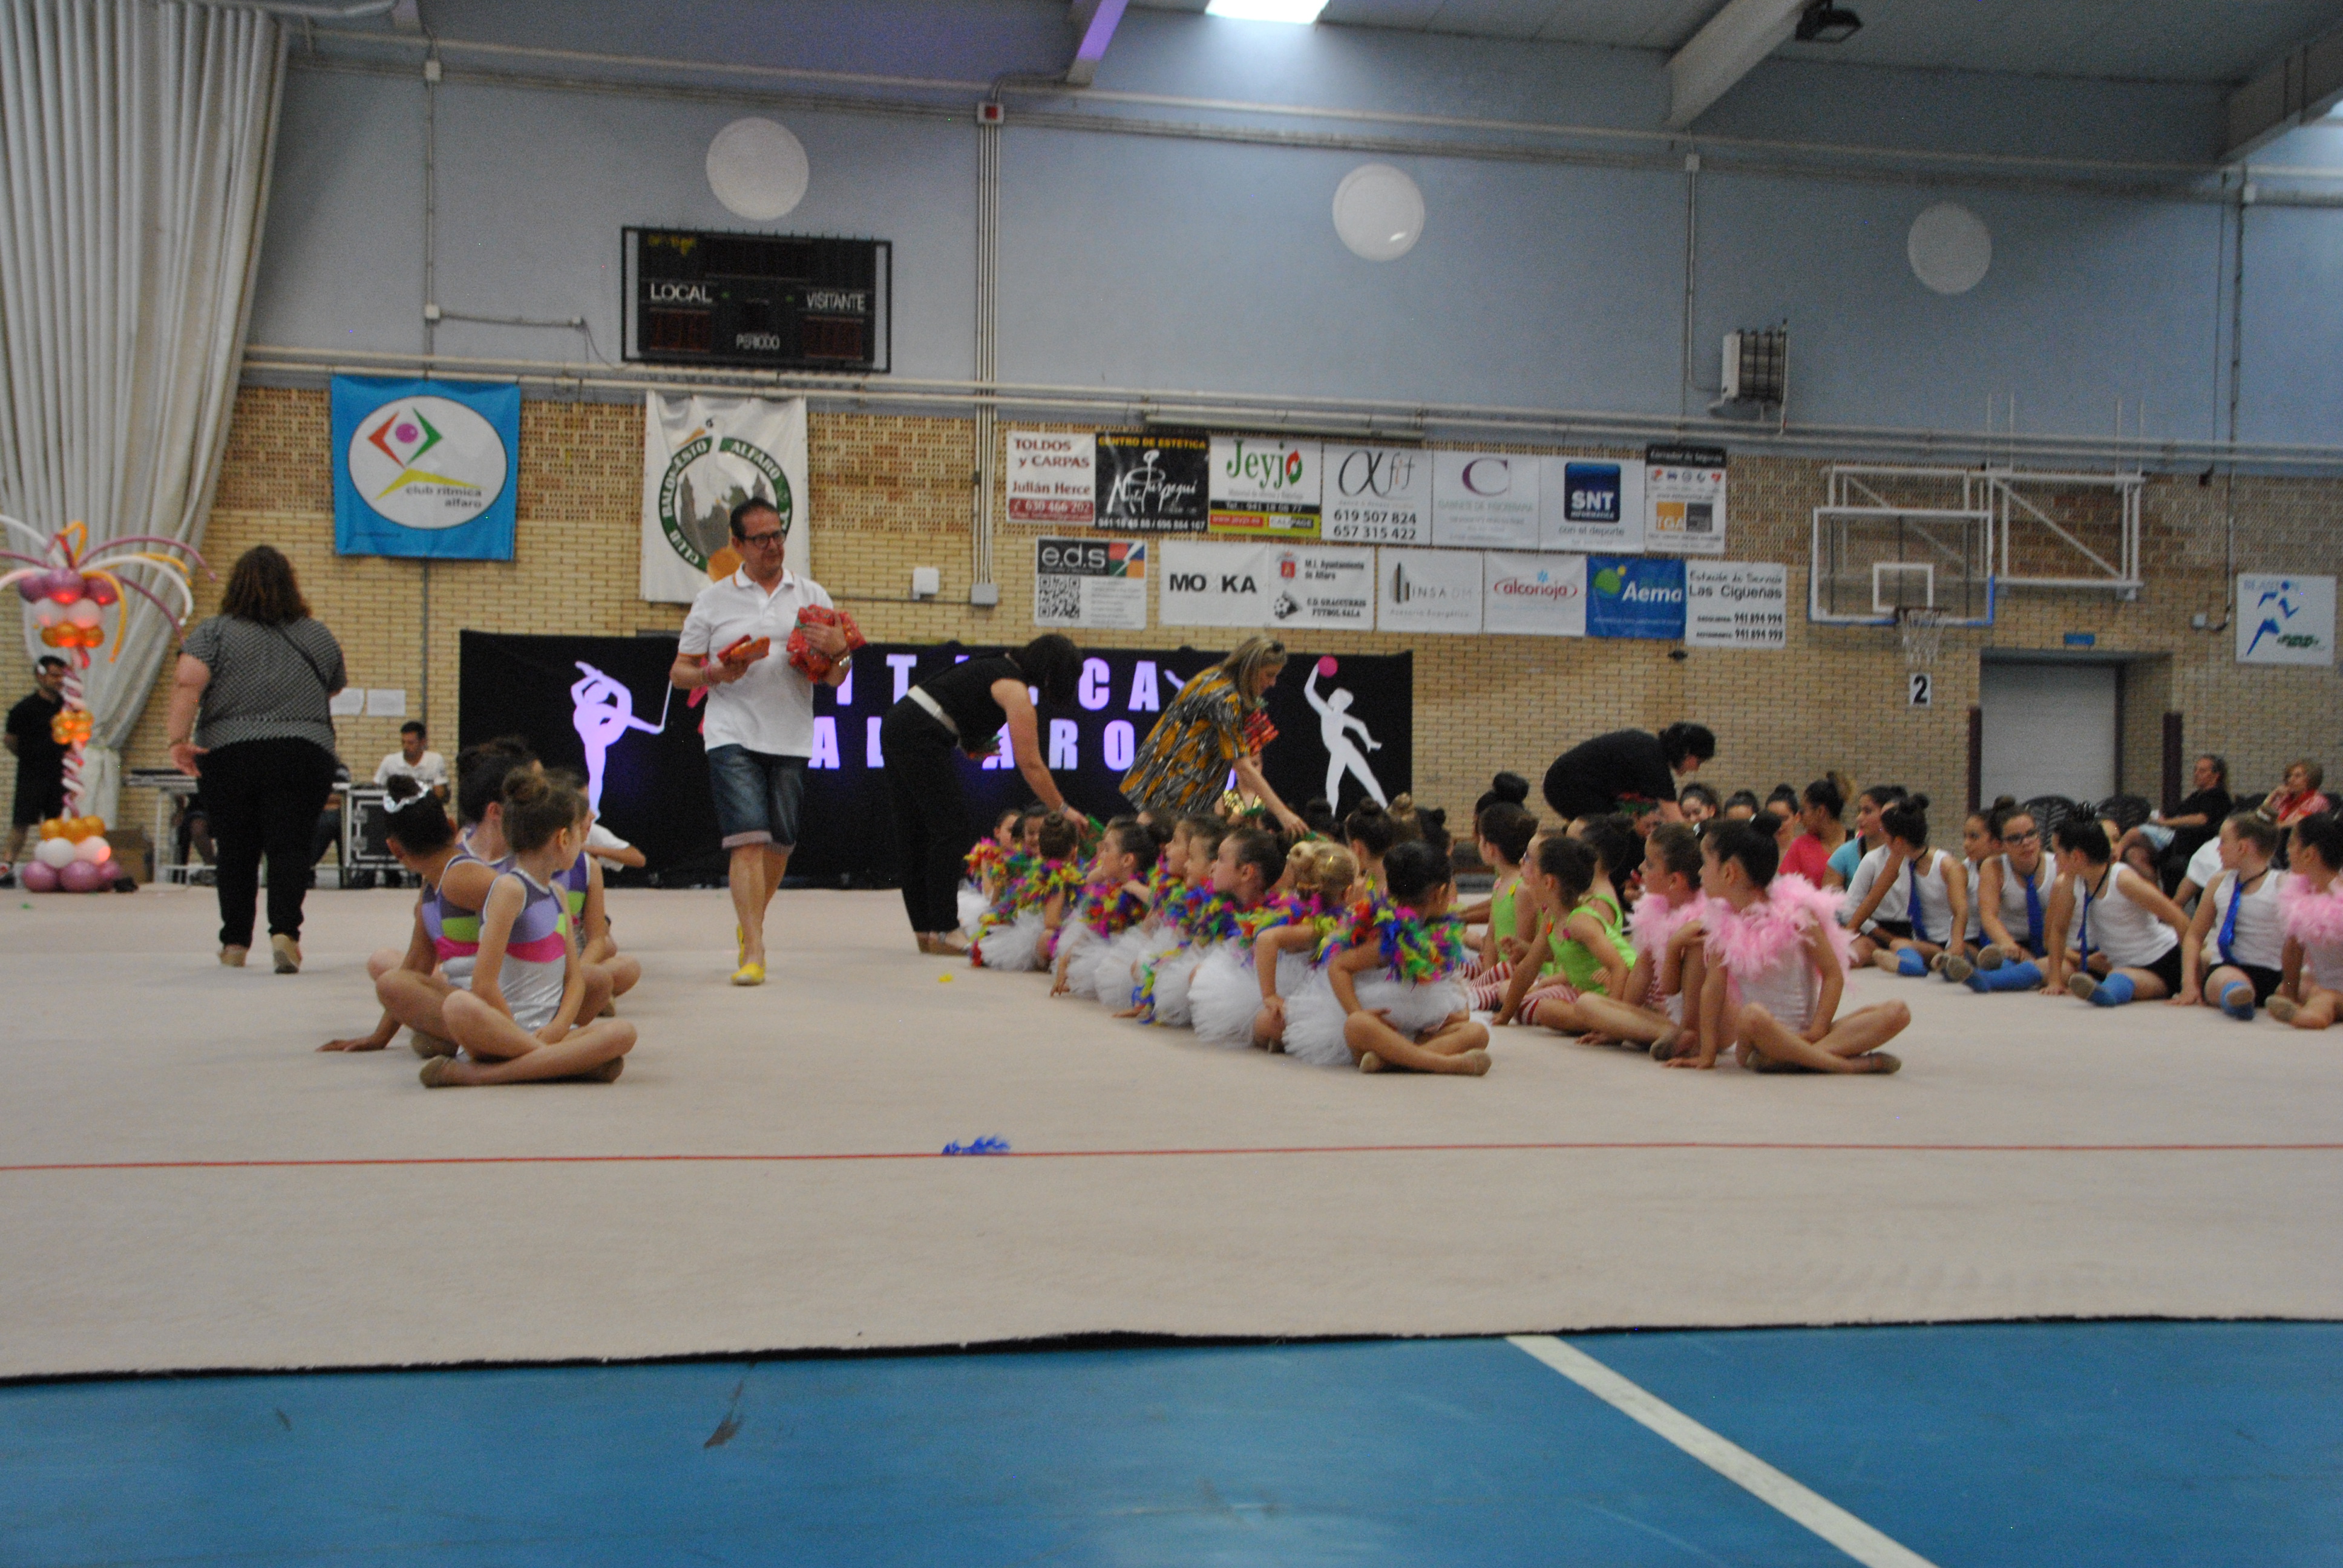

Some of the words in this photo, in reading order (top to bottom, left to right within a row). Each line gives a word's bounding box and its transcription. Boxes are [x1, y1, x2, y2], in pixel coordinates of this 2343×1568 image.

[650, 283, 713, 301] LOCAL
[807, 292, 865, 311] VISITANTE
[1014, 438, 1072, 452] TOLDOS
[730, 440, 781, 480] ALFARO
[1018, 457, 1027, 468] y
[1032, 454, 1090, 468] CARPAS
[662, 440, 707, 518] BALOESTO
[406, 486, 433, 496] club
[445, 498, 482, 508] alfaro
[1571, 490, 1614, 511] SNT
[1334, 508, 1360, 522] 619
[1363, 509, 1388, 524] 507
[1391, 511, 1417, 526] 824
[1333, 524, 1359, 538] 657
[1363, 525, 1388, 540] 315
[1391, 526, 1417, 541] 422
[1558, 526, 1576, 535] con
[1588, 526, 1625, 537] deporte
[669, 530, 700, 565] CLUB
[1041, 543, 1106, 569] e.d.s
[1169, 574, 1207, 591] MO
[1221, 575, 1257, 593] KA
[1620, 581, 1683, 603] Aema
[1689, 584, 1713, 598] Las
[1734, 612, 1748, 624] 941
[1735, 628, 1749, 640] 941
[1913, 674, 1928, 704] 2
[808, 716, 1135, 771] ALARO
